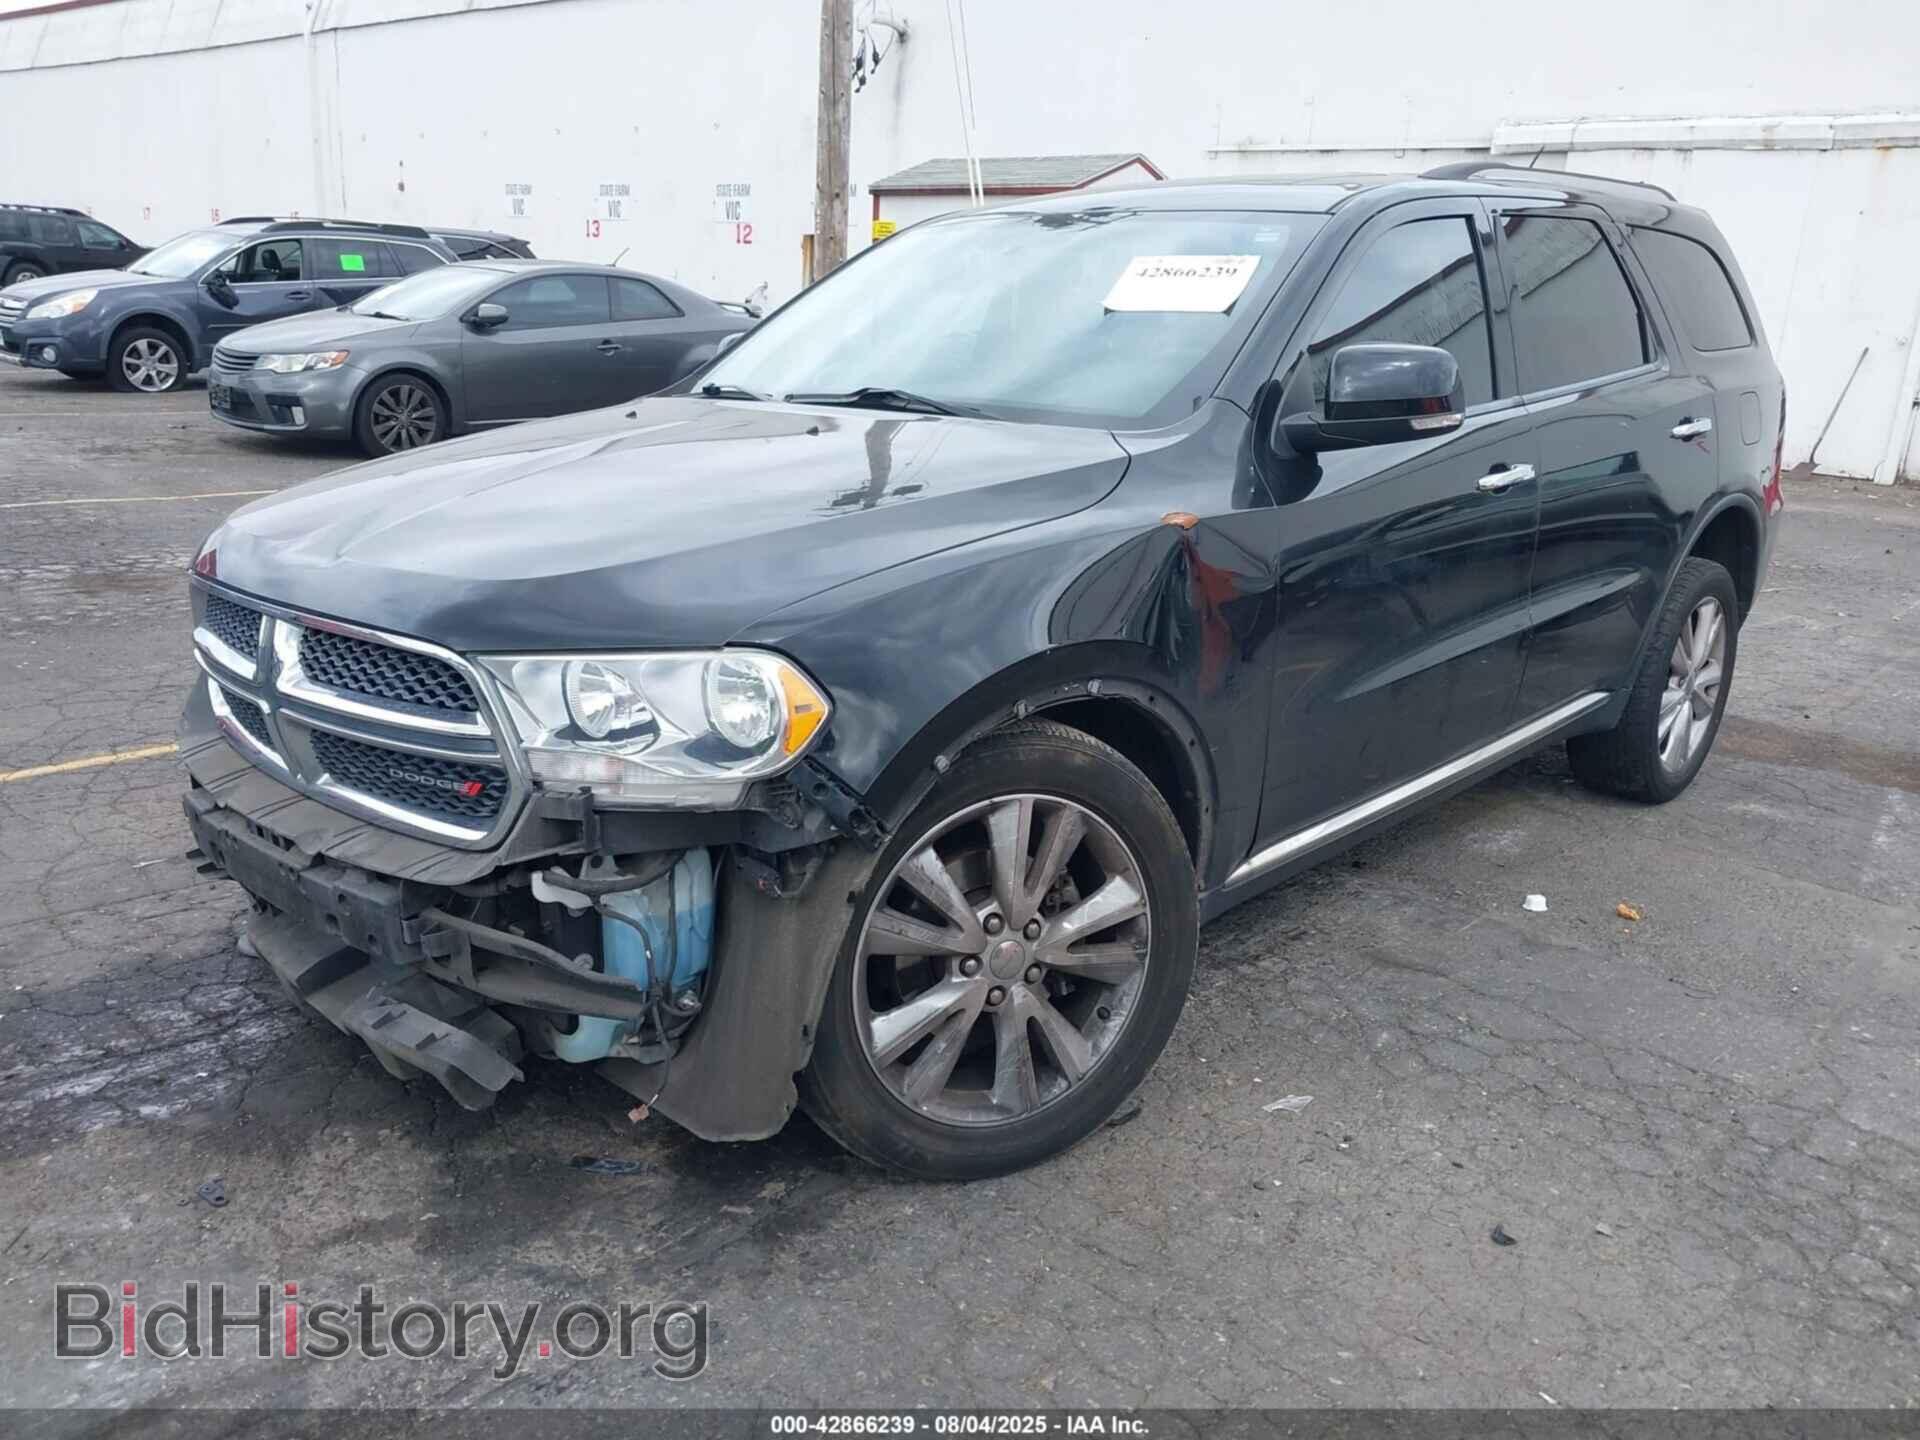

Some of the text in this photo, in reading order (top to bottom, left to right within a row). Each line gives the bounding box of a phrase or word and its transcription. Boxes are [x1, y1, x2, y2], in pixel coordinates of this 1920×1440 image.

[716, 184, 751, 198] STATE FARM
[607, 200, 621, 218] VIC
[725, 201, 741, 221] VIC
[586, 219, 601, 238] 13
[736, 223, 753, 244] 12
[389, 768, 466, 793] DODGE
